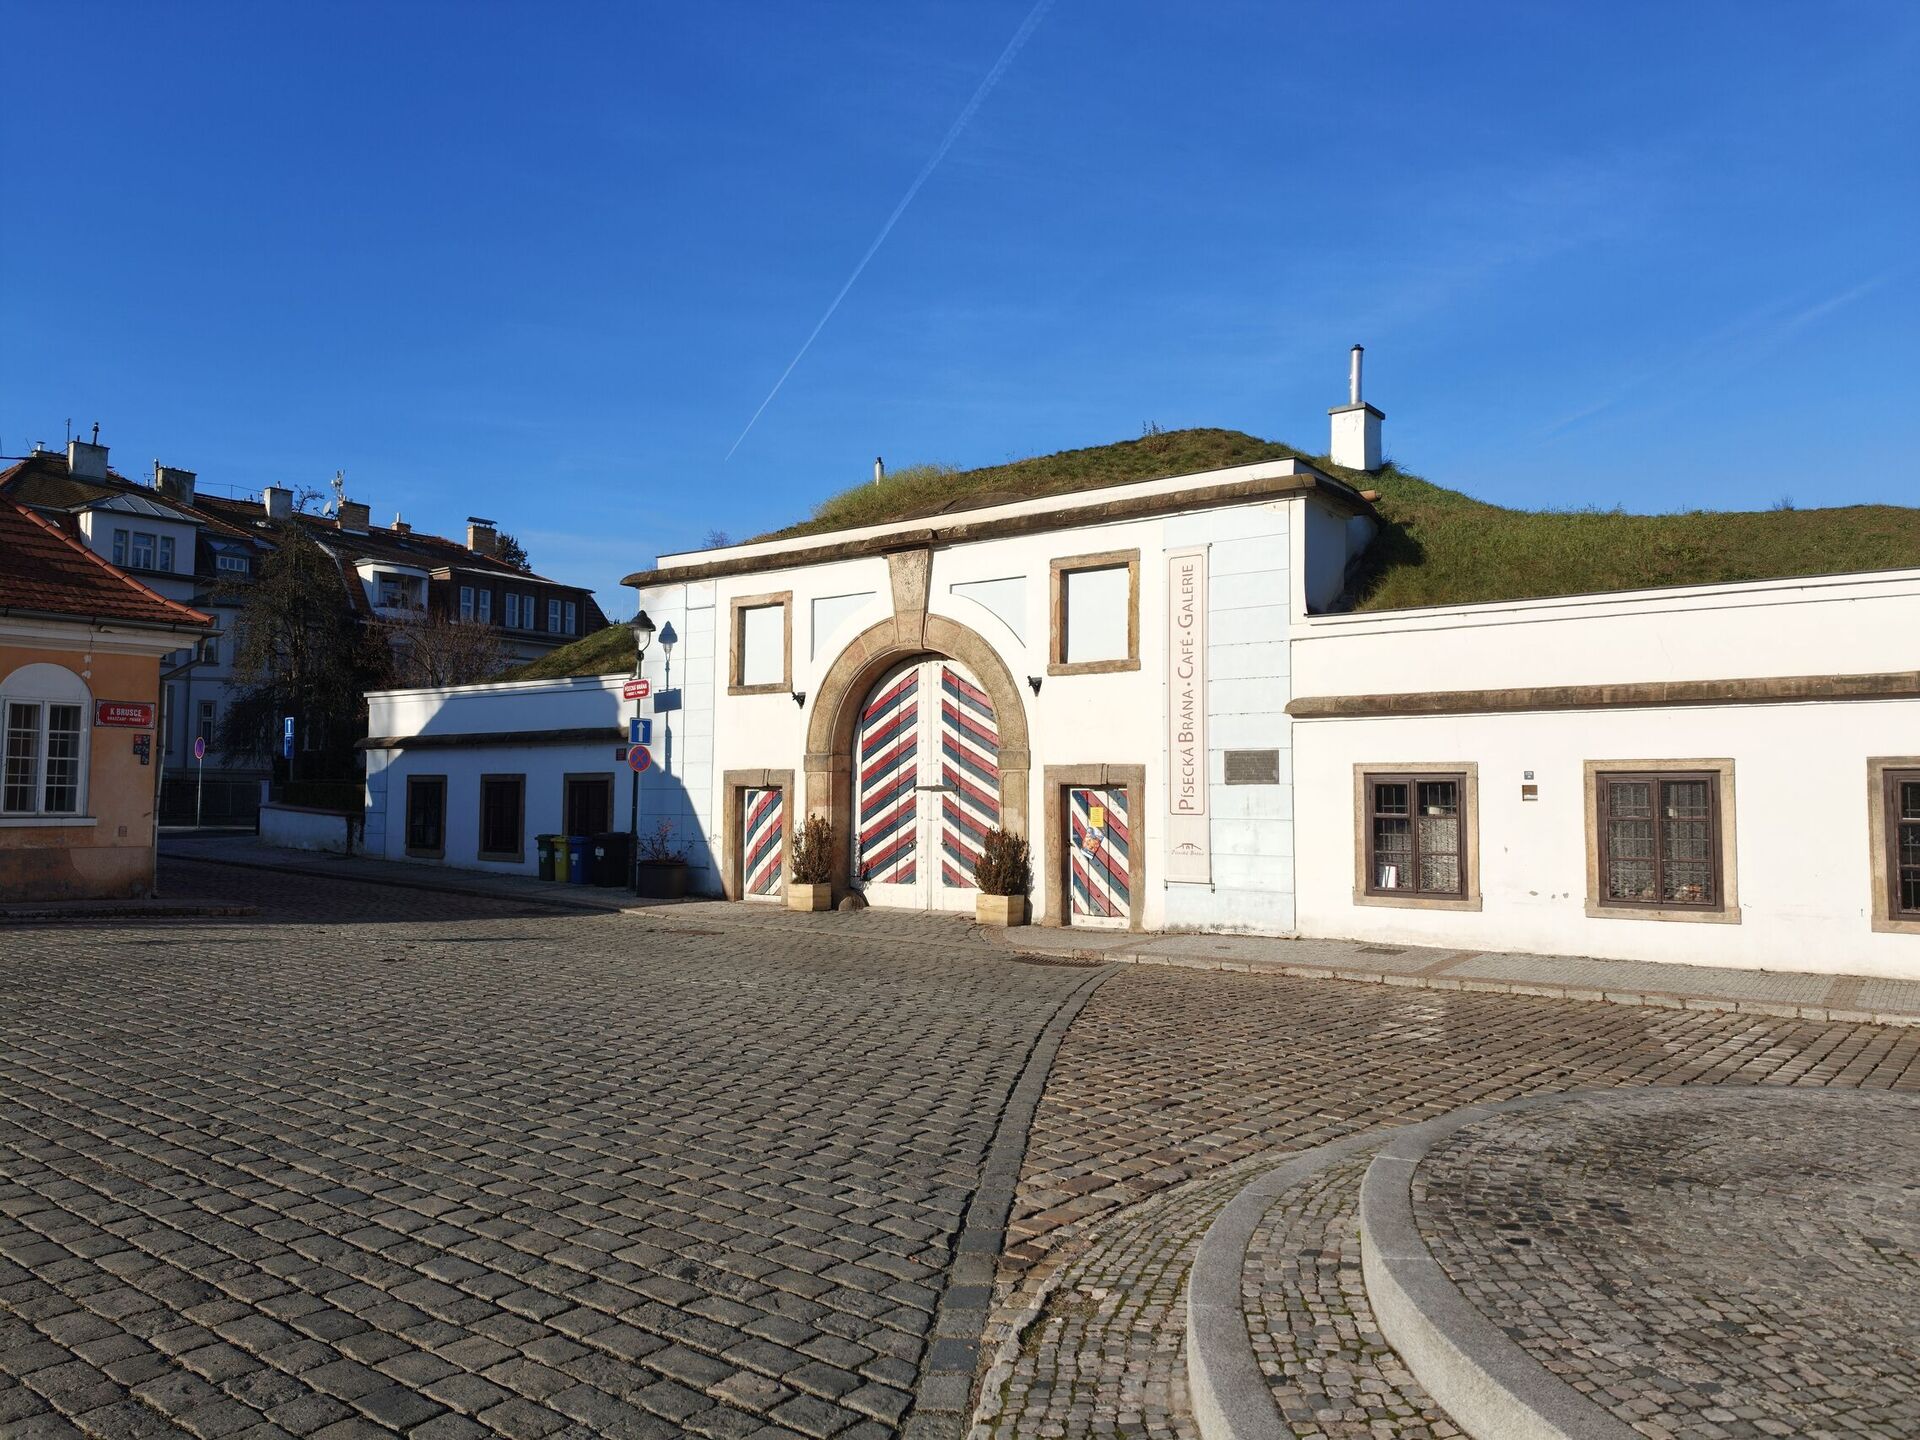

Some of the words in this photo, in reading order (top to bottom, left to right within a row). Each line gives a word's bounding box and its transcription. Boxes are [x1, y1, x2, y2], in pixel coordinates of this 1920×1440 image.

[1177, 564, 1194, 628] GALERIE
[1177, 637, 1194, 679] CAFÉ
[110, 708, 115, 716] K
[116, 708, 142, 717] BRUSCE
